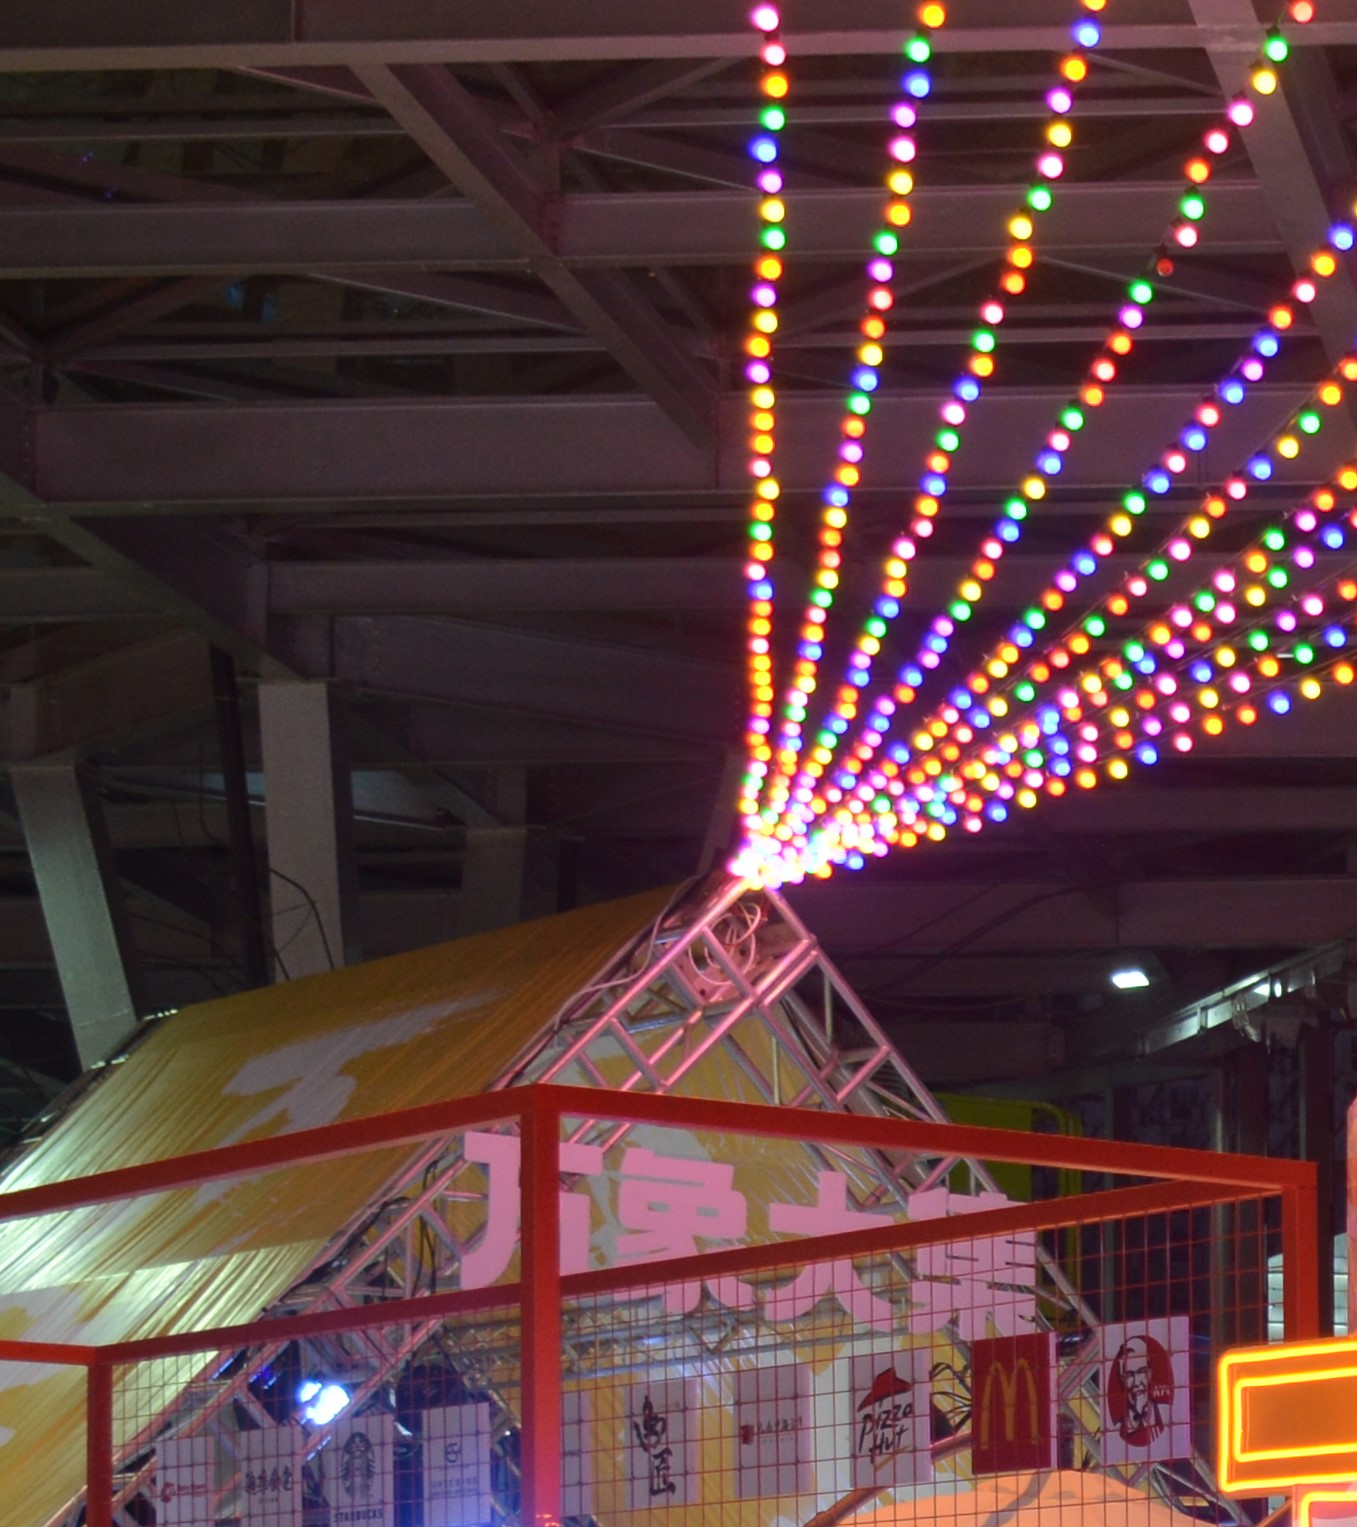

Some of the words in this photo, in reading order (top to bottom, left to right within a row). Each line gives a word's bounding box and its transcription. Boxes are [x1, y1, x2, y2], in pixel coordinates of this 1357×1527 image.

[858, 1399, 912, 1453] Pizza
[869, 1427, 909, 1464] Hut
[333, 1508, 384, 1524] STARBUCKS
